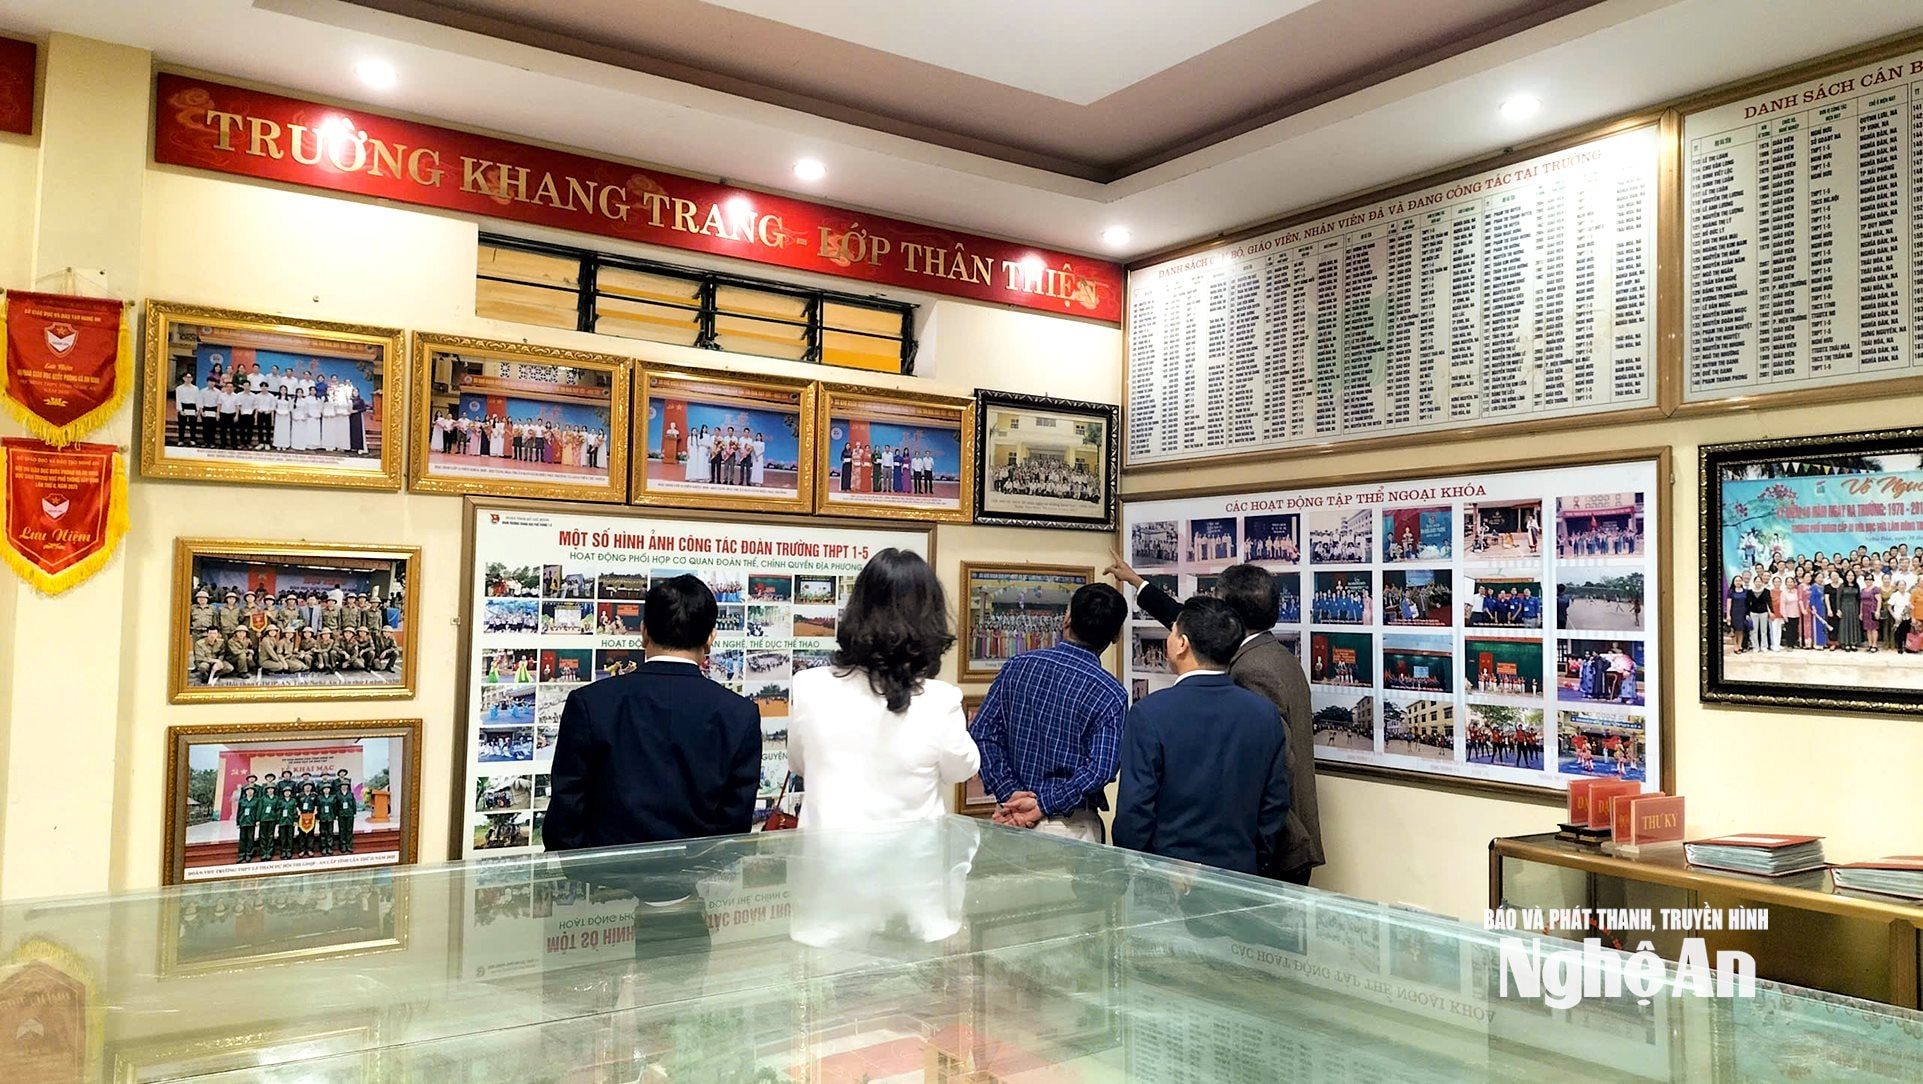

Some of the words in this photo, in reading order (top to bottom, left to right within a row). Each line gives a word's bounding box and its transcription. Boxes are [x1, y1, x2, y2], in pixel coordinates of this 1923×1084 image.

[1744, 94, 1798, 120] DANH
[1803, 78, 1855, 104] SÁCH
[1860, 66, 1904, 88] CÁN
[206, 108, 444, 187] TRƯỜNG
[459, 156, 631, 223] KHANG
[644, 191, 785, 249] TRANG
[817, 222, 892, 267] LỚP
[900, 241, 993, 287] THÂN
[1003, 260, 1097, 308] THIỆN
[1158, 265, 1182, 278] DANH
[1185, 258, 1208, 272] SÁCH
[1247, 240, 1272, 255] GIÁO
[1304, 222, 1335, 239] NHÂN
[1338, 213, 1365, 230] VIÊN
[1368, 206, 1384, 221] ĐÃ
[1388, 202, 1404, 215] VÀ
[1408, 191, 1443, 210] ĐANG
[1446, 182, 1482, 200] CÔNG
[1485, 173, 1512, 189] TÁC
[1225, 500, 1248, 512] CÁC
[1250, 500, 1284, 512] HOẠT
[1287, 496, 1323, 510] ĐỘNG
[1327, 492, 1352, 508] TẬP
[1356, 486, 1384, 504] THỂ
[1388, 488, 1436, 502] NGOẠI
[1441, 482, 1486, 498] KHÓA
[19, 526, 46, 540] Lưu
[52, 528, 90, 544] Niệm
[559, 528, 588, 550] MỘT
[592, 528, 610, 548] SỐ
[614, 530, 644, 550] HÌNH
[649, 529, 674, 551] ẢNH
[679, 535, 712, 553] CÔNG
[715, 536, 737, 554] TÁC
[741, 538, 773, 556] ĐOÀN
[776, 539, 820, 558] TRƯỜNG
[823, 544, 849, 558] THPT
[852, 546, 869, 560] 1-5
[570, 552, 595, 561] HOẠT
[598, 552, 626, 563] ĐỘNG
[629, 551, 650, 563] PHỐI
[652, 554, 670, 565] HỢP
[673, 555, 687, 565] CƠ
[689, 557, 714, 566] QUAN
[716, 557, 741, 567] ĐOÀN
[761, 558, 785, 569] CHÍNH
[788, 560, 813, 570] QUYỀN
[816, 561, 828, 570] ĐỊA
[831, 562, 862, 571] PHƯƠNG
[601, 640, 626, 649] HOẠT
[628, 638, 642, 649] ĐỘ
[766, 640, 782, 649] DỤC
[762, 751, 788, 761] GUYỆN
[1642, 814, 1663, 830] THƯ
[1664, 812, 1678, 827] KÝ
